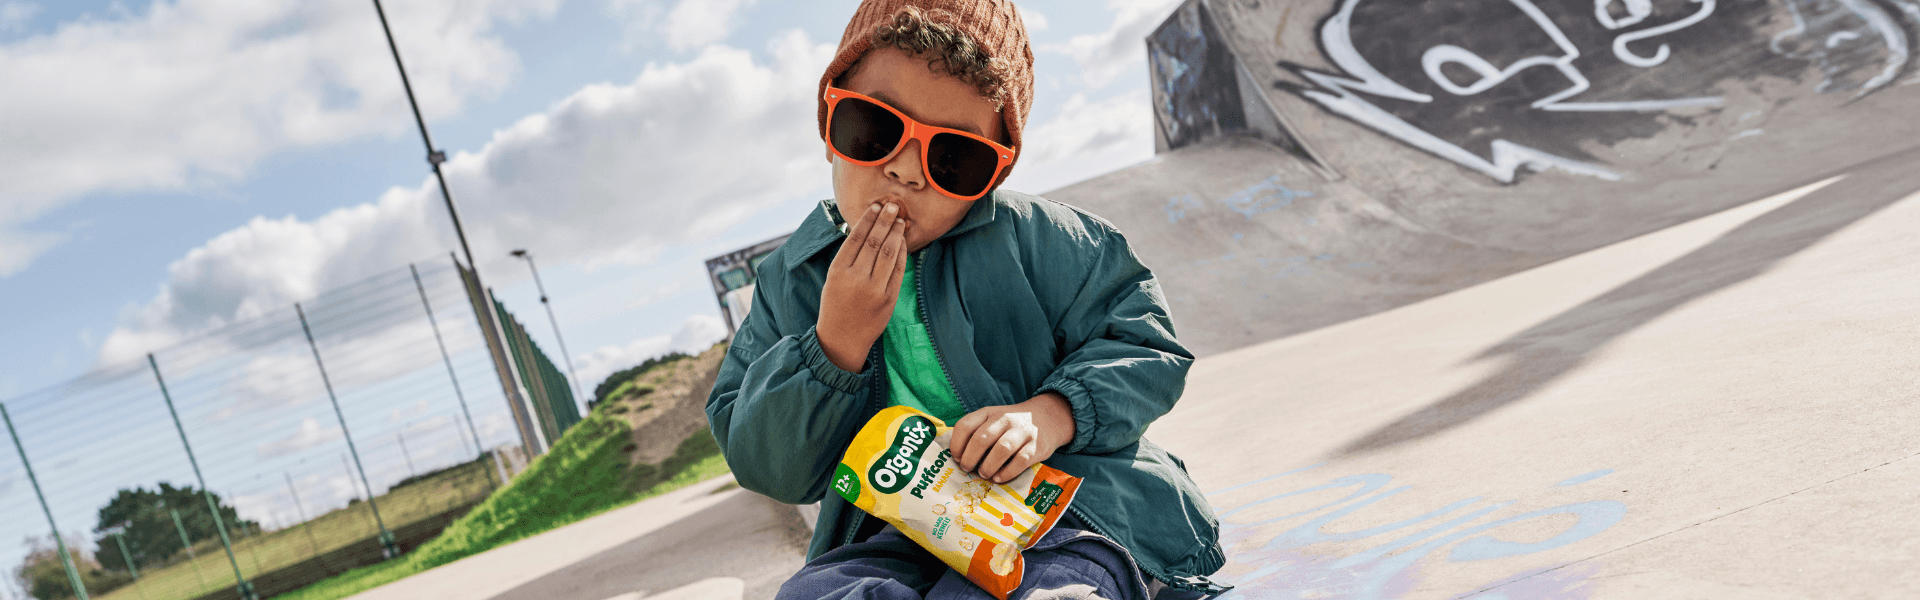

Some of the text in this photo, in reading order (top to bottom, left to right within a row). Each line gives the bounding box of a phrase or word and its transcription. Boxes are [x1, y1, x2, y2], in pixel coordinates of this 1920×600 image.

[875, 421, 930, 488] Organix
[835, 474, 850, 492] 12+
[932, 467, 954, 492] BANANA
